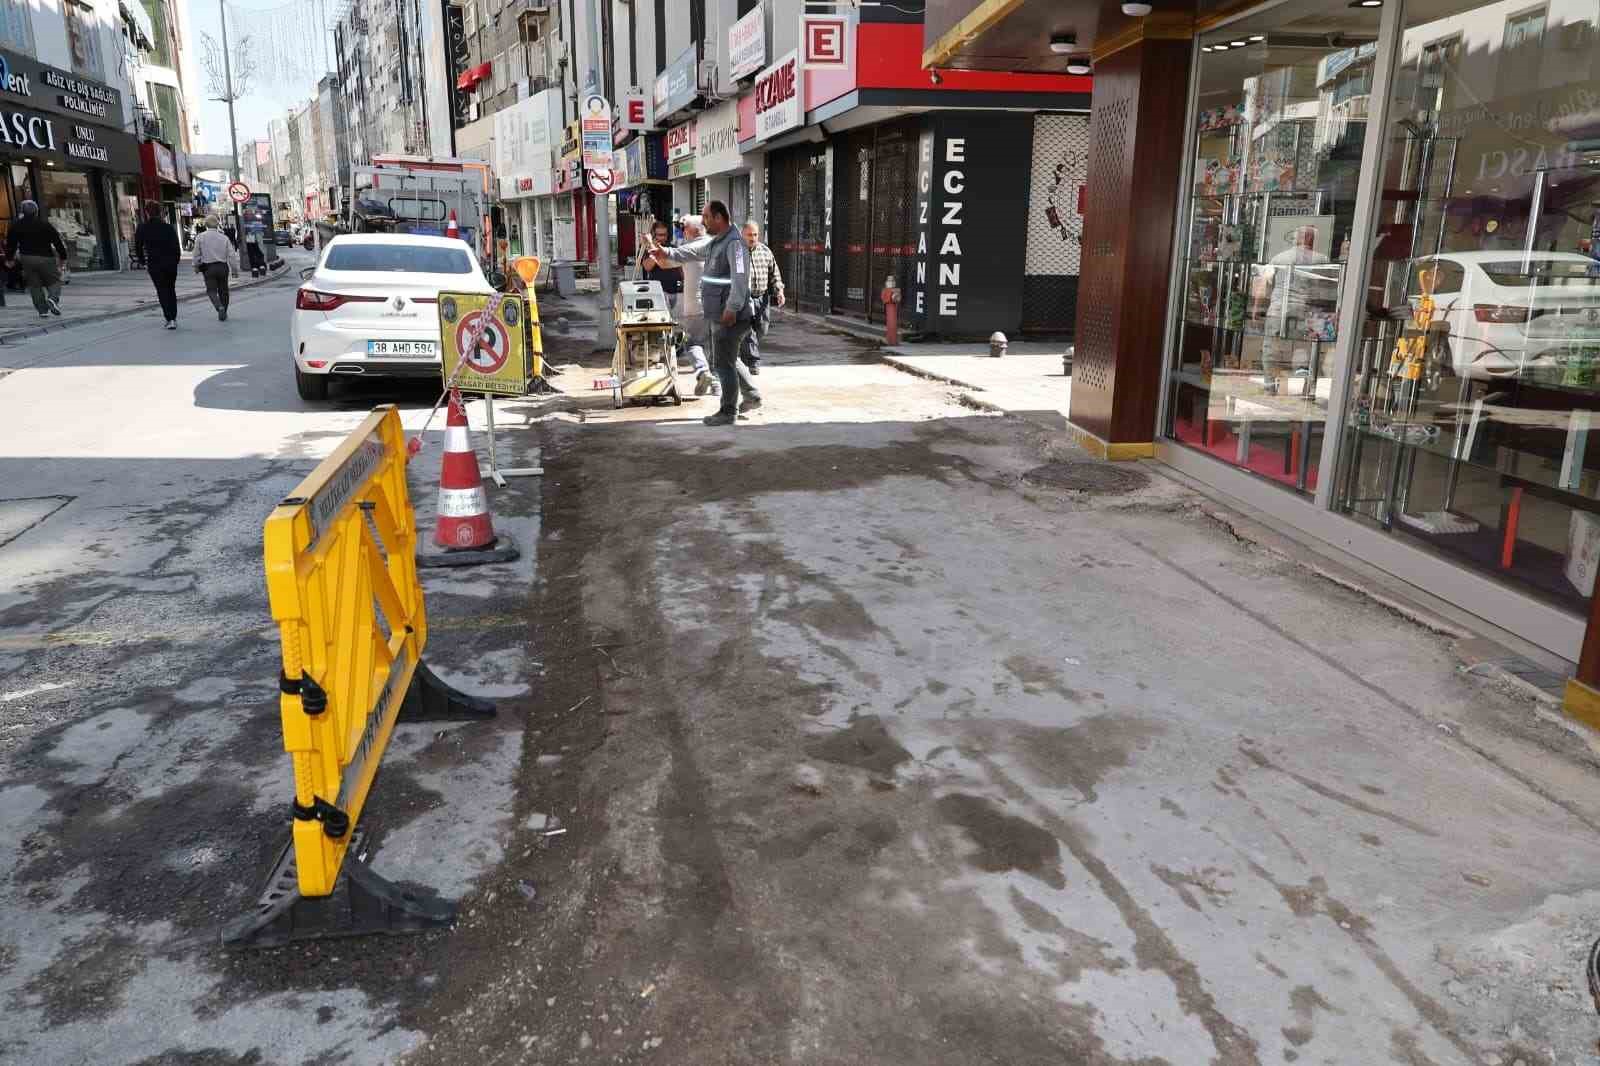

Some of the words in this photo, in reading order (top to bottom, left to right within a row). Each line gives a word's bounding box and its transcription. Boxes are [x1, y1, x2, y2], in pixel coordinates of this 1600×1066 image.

[814, 28, 834, 55] E
[46, 71, 66, 89] AĞIZ
[67, 79, 77, 92] VE
[755, 58, 795, 114] ECZANE
[629, 100, 645, 123] E
[669, 126, 688, 149] ECZANE
[824, 150, 833, 298] CZANE
[916, 144, 931, 314] ECZANE
[939, 138, 966, 316] ECZANE
[375, 341, 387, 354] 38
[392, 341, 411, 354] AHD
[414, 342, 433, 354] 594
